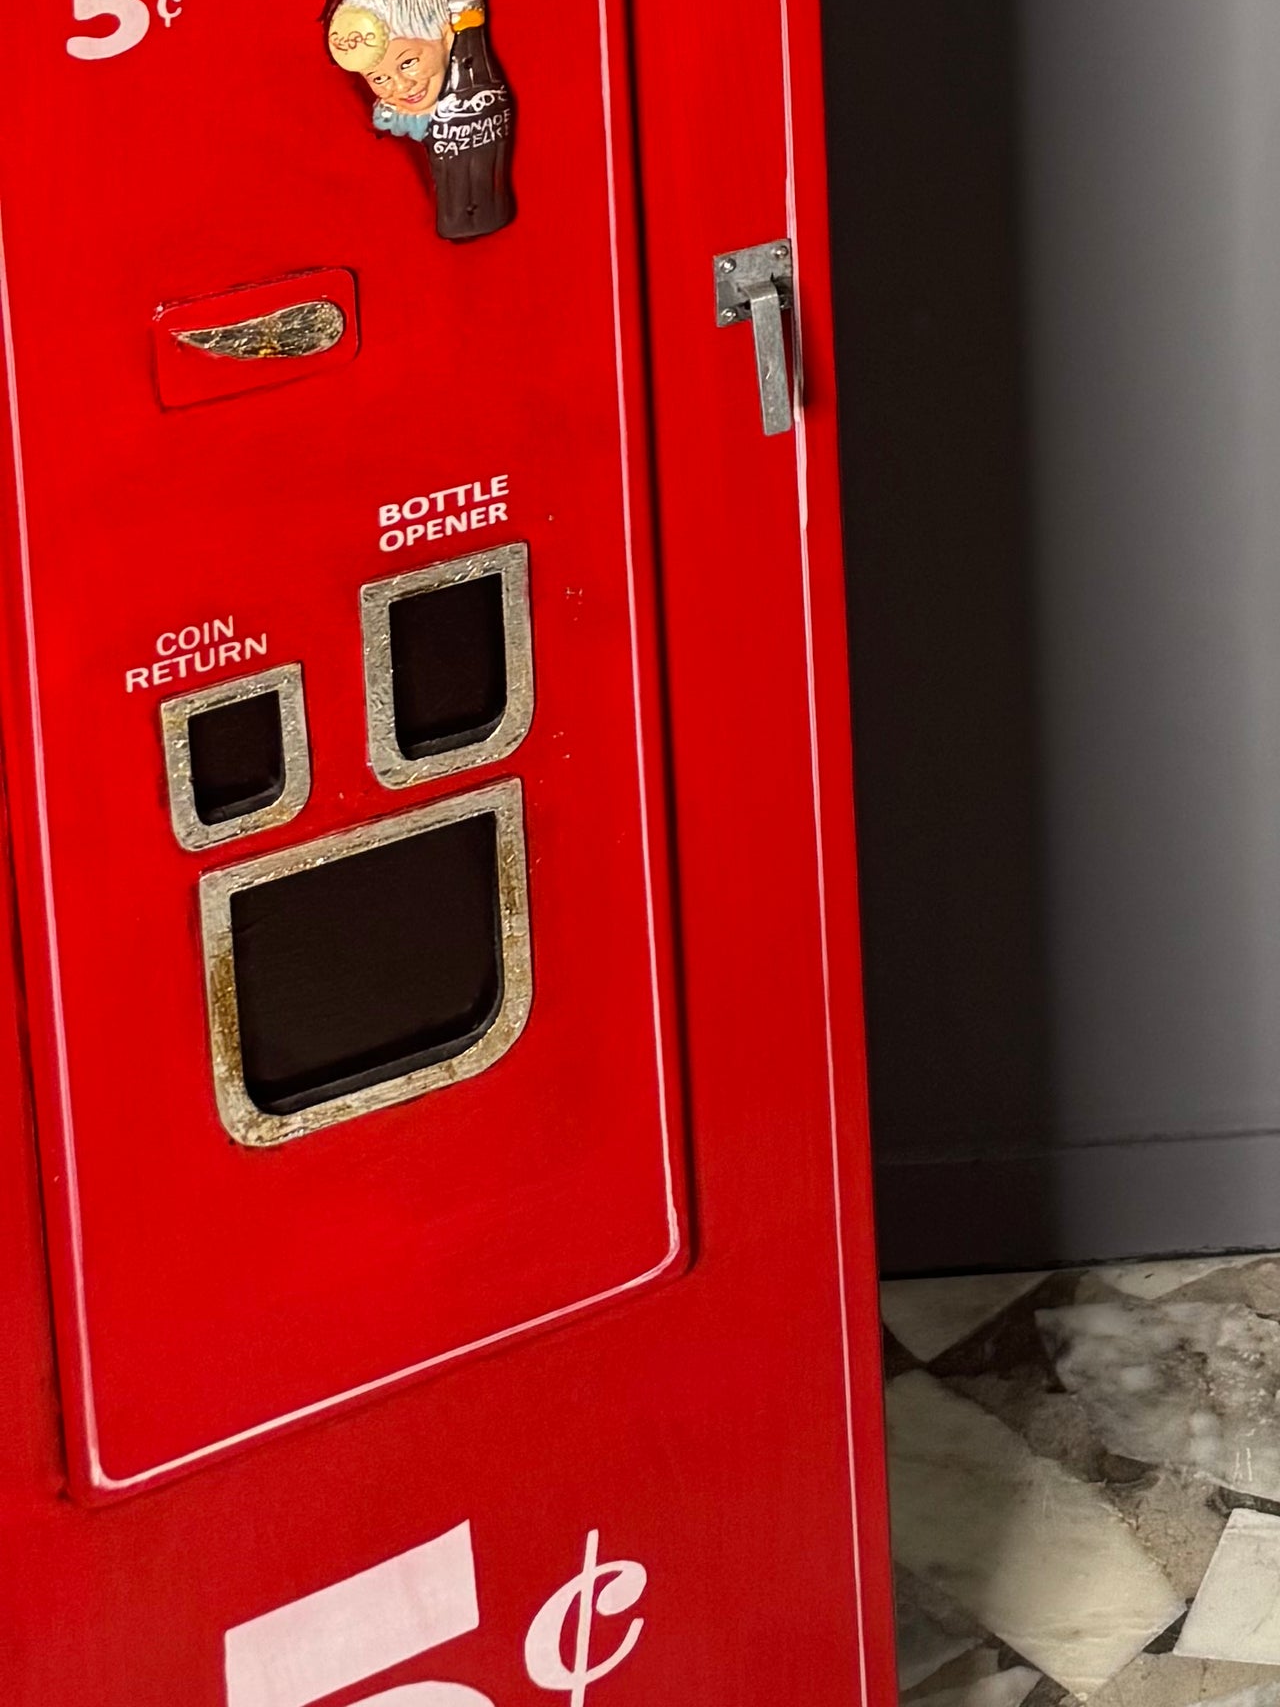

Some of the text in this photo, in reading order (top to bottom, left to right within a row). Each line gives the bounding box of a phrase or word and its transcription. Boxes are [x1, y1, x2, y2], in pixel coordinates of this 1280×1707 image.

[378, 474, 510, 528] BOTTLE
[378, 502, 509, 553] OPENER
[155, 615, 235, 657] COIN
[125, 633, 268, 694] RETURN
